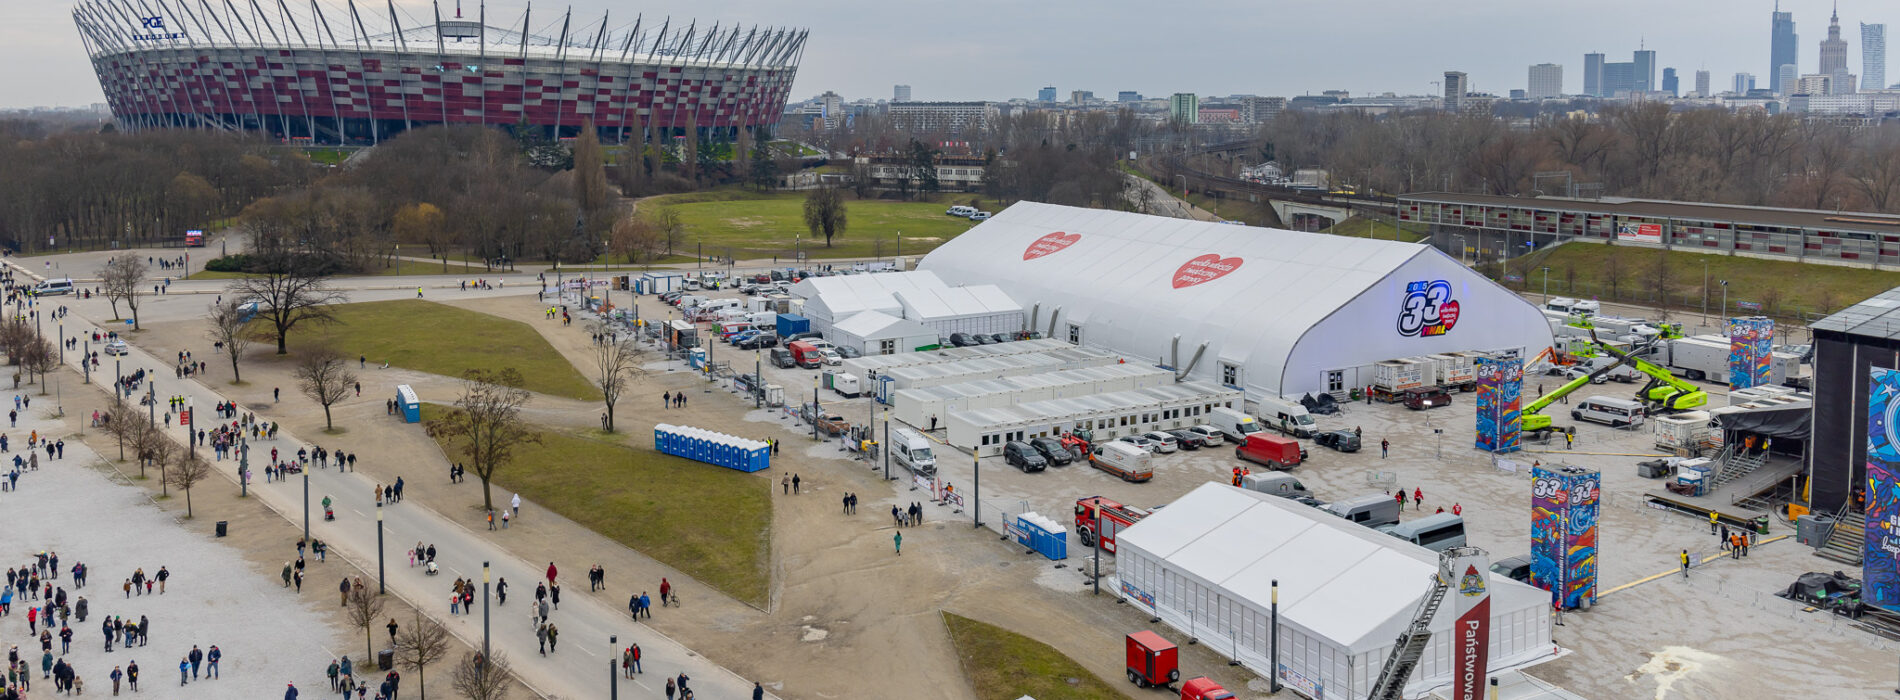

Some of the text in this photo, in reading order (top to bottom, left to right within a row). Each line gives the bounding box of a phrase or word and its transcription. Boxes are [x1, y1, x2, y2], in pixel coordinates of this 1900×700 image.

[142, 17, 163, 28] PGE
[1399, 281, 1451, 335] 33
[1479, 364, 1498, 378] 33
[1534, 478, 1562, 498] 33
[1572, 479, 1595, 504] 33
[1464, 620, 1480, 700] Państwowa
